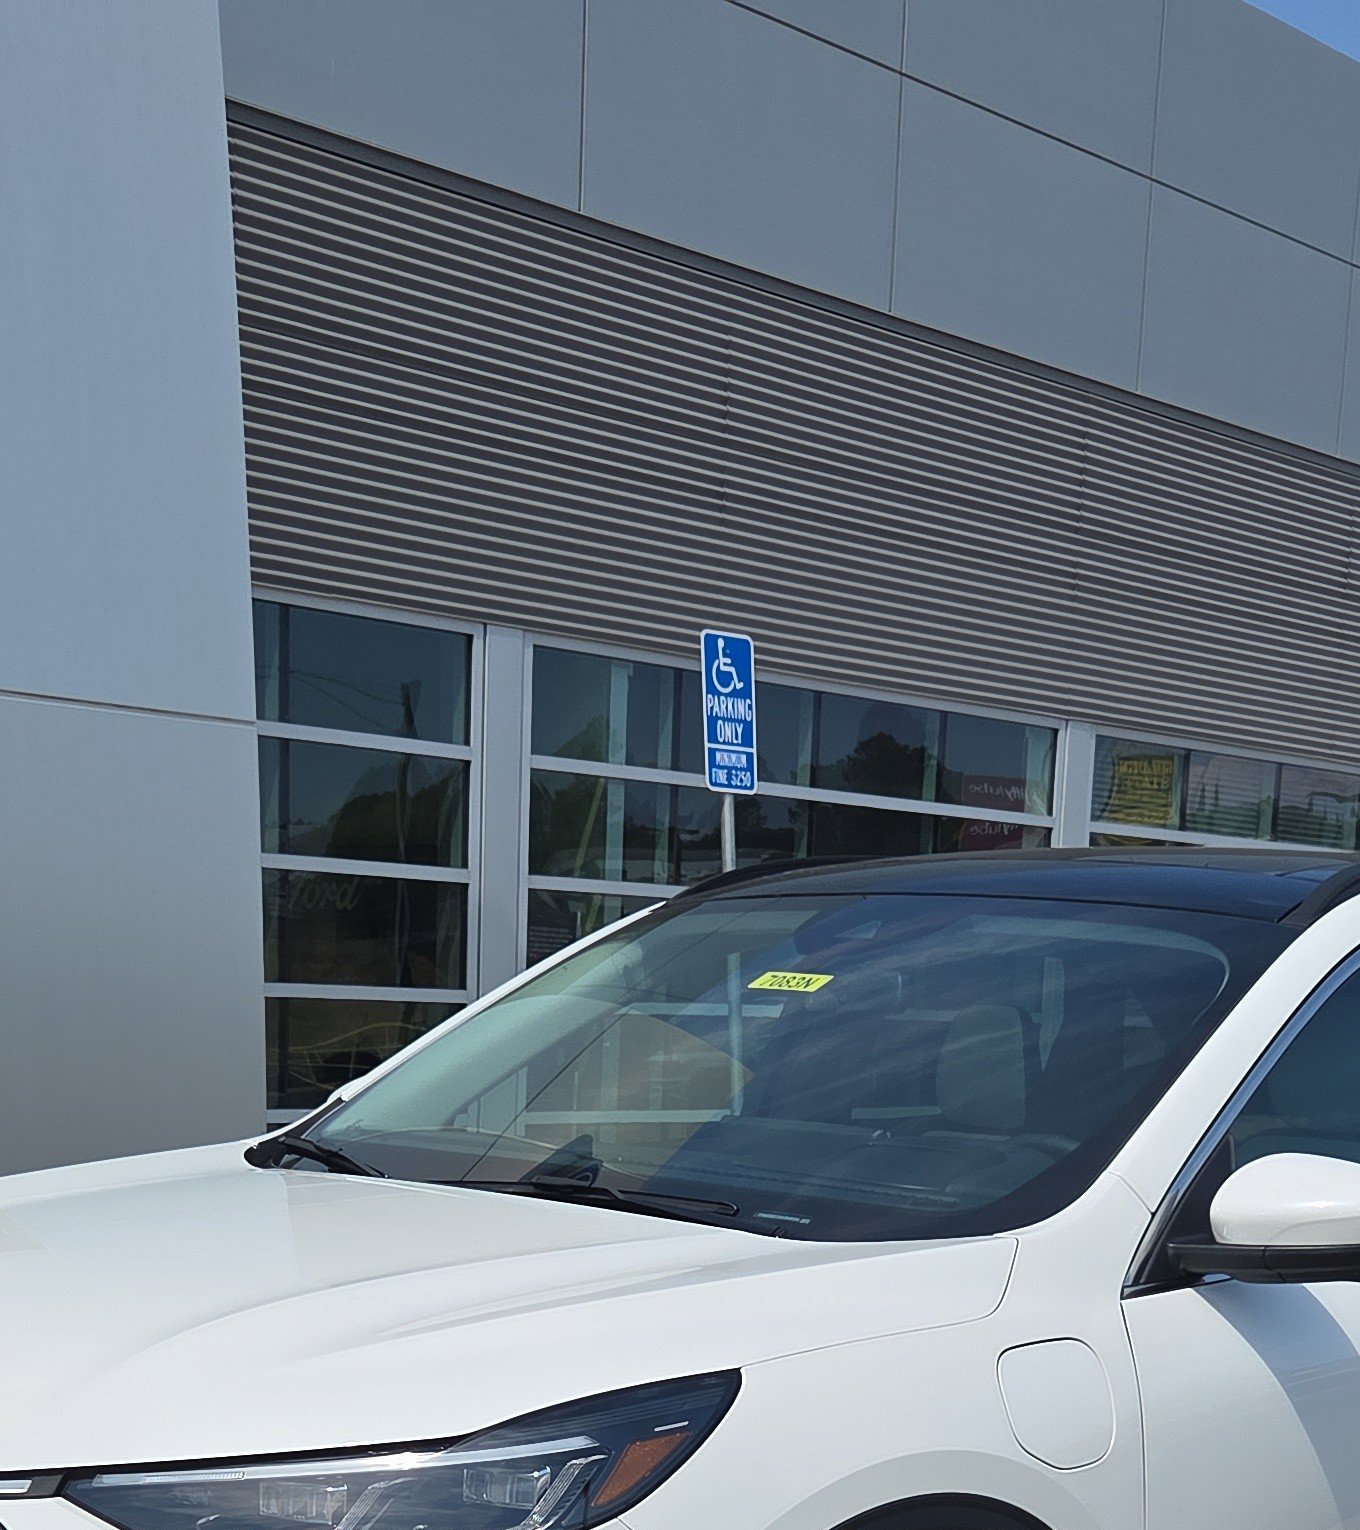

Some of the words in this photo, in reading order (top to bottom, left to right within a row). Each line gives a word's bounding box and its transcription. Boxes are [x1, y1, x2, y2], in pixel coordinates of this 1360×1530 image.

[707, 693, 752, 722] PARKING
[716, 721, 744, 744] ONLY
[711, 768, 728, 785] FINE
[759, 975, 820, 989] 7083N
